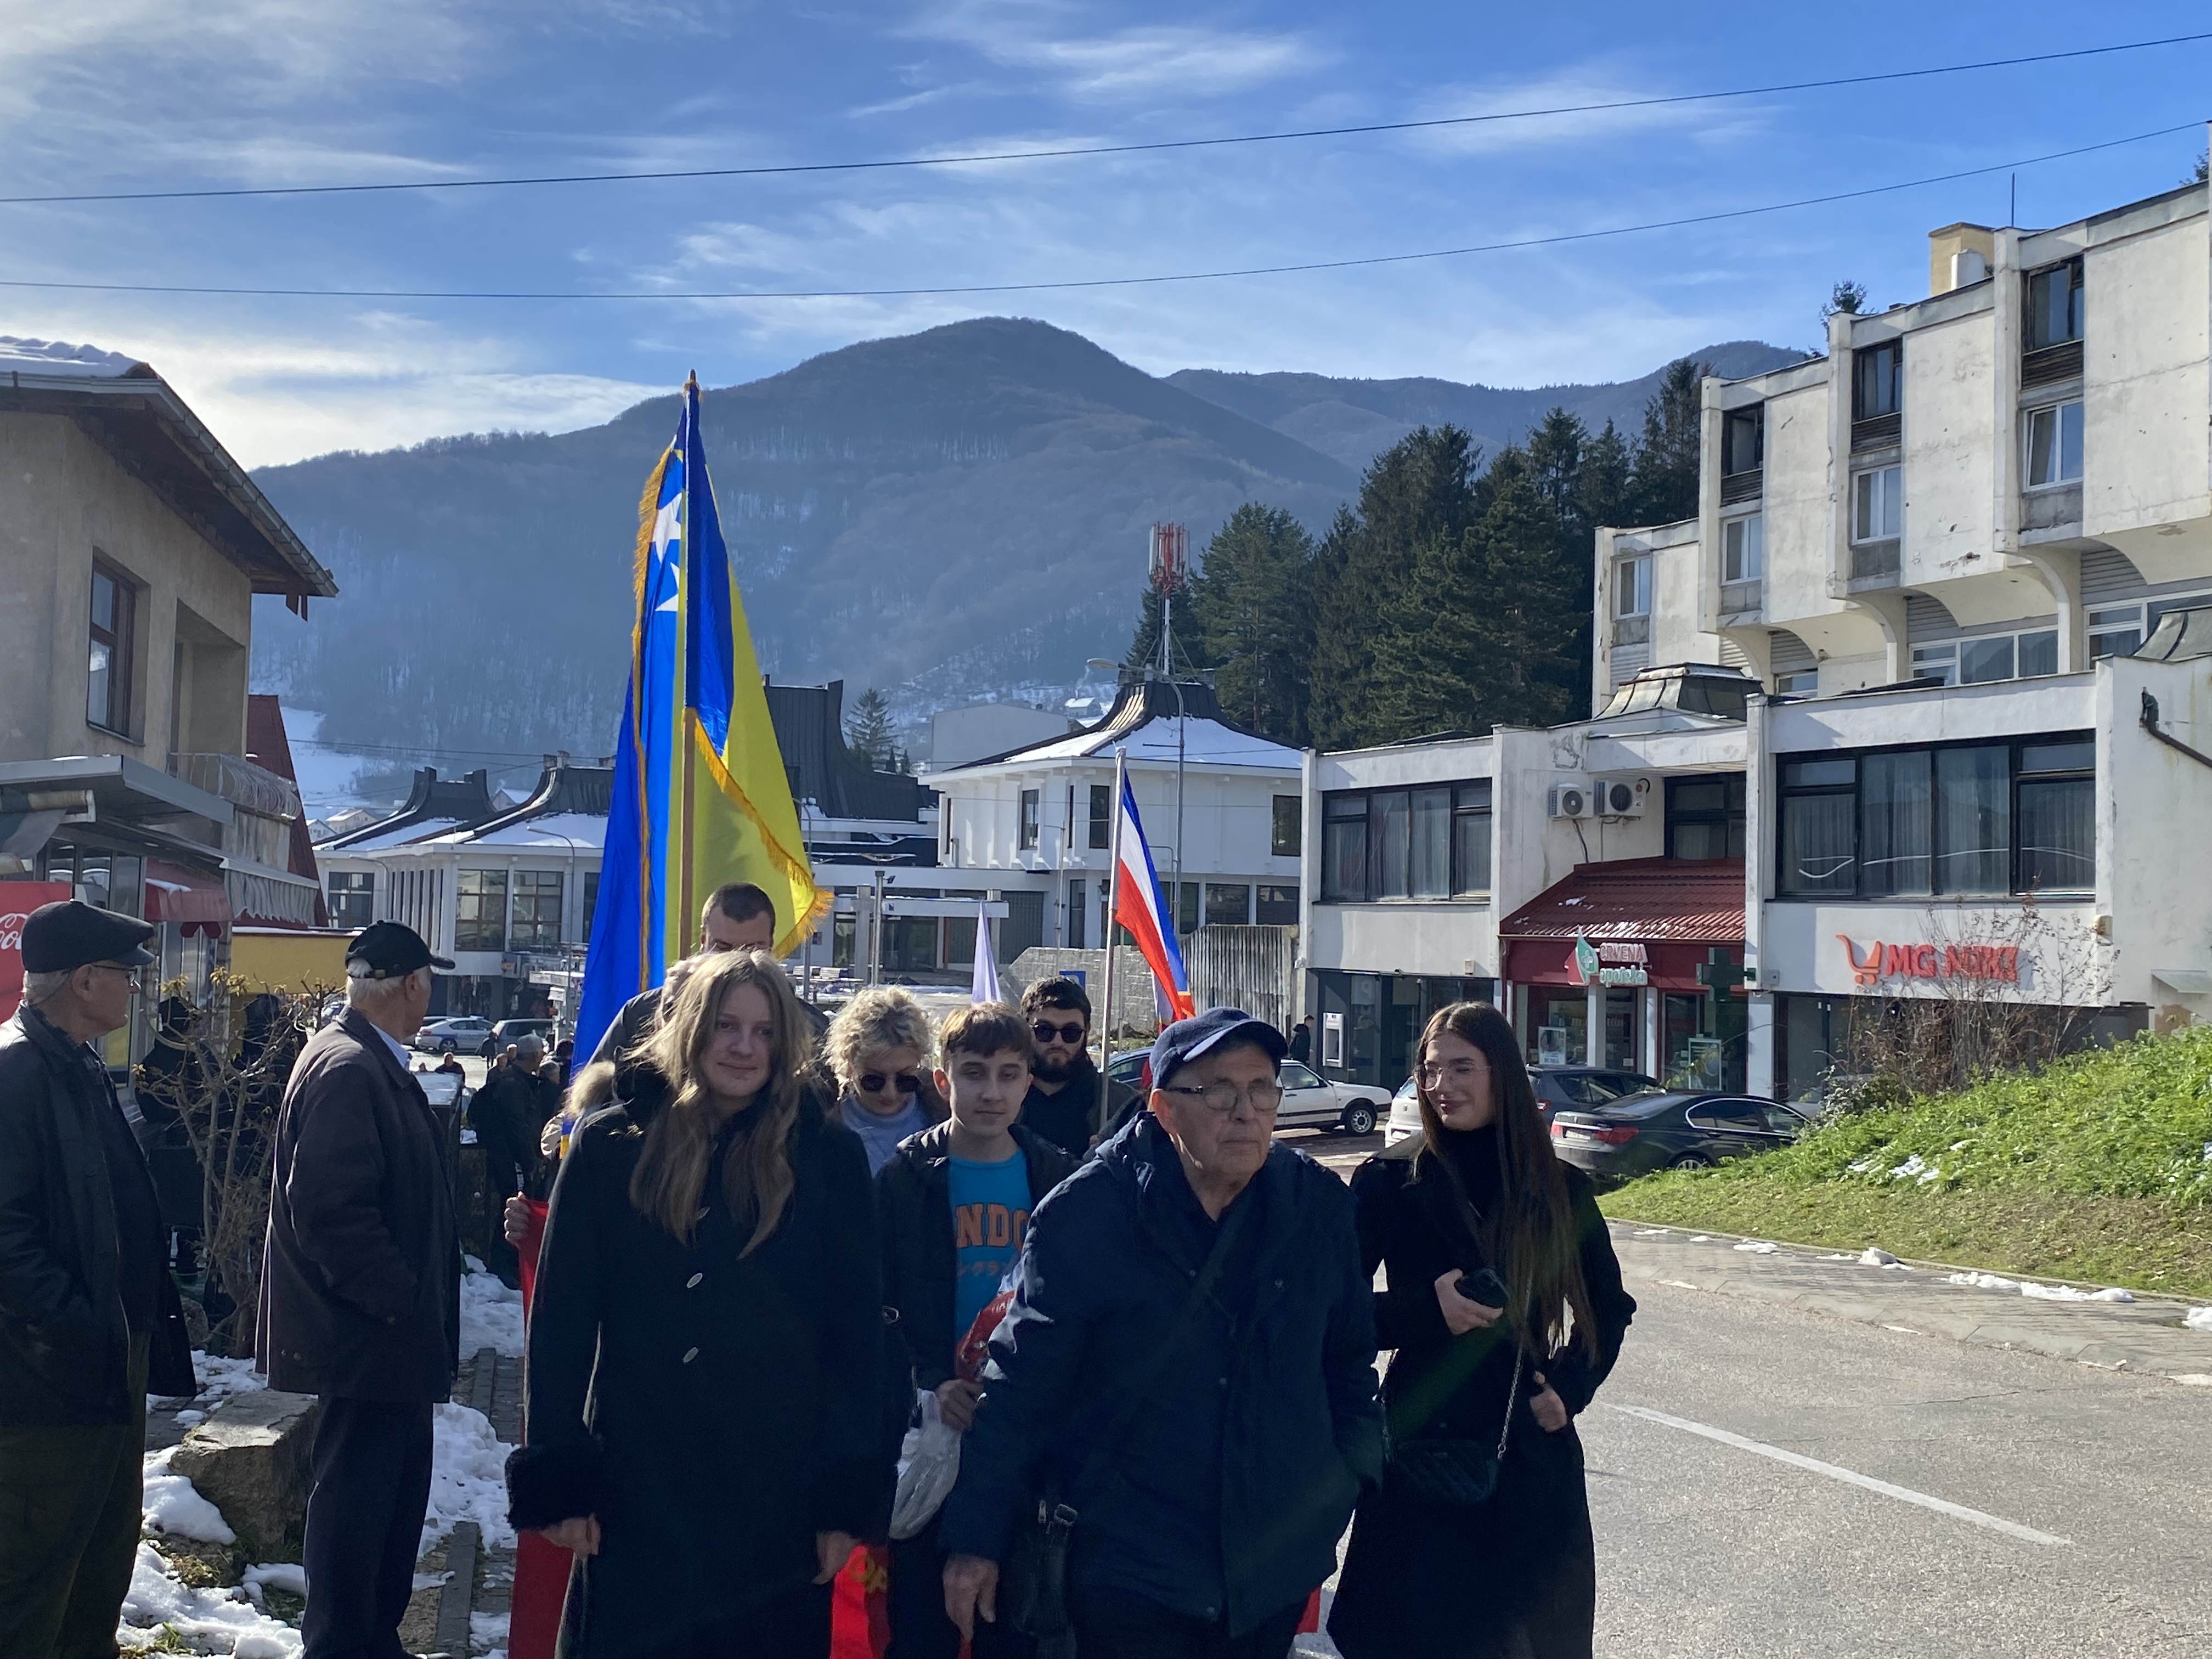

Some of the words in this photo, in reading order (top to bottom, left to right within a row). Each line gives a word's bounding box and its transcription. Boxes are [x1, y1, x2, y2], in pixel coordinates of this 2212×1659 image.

[1600, 942, 1648, 963] CRVENA
[1886, 944, 1936, 978] MG
[1599, 965, 1648, 988] apoteka
